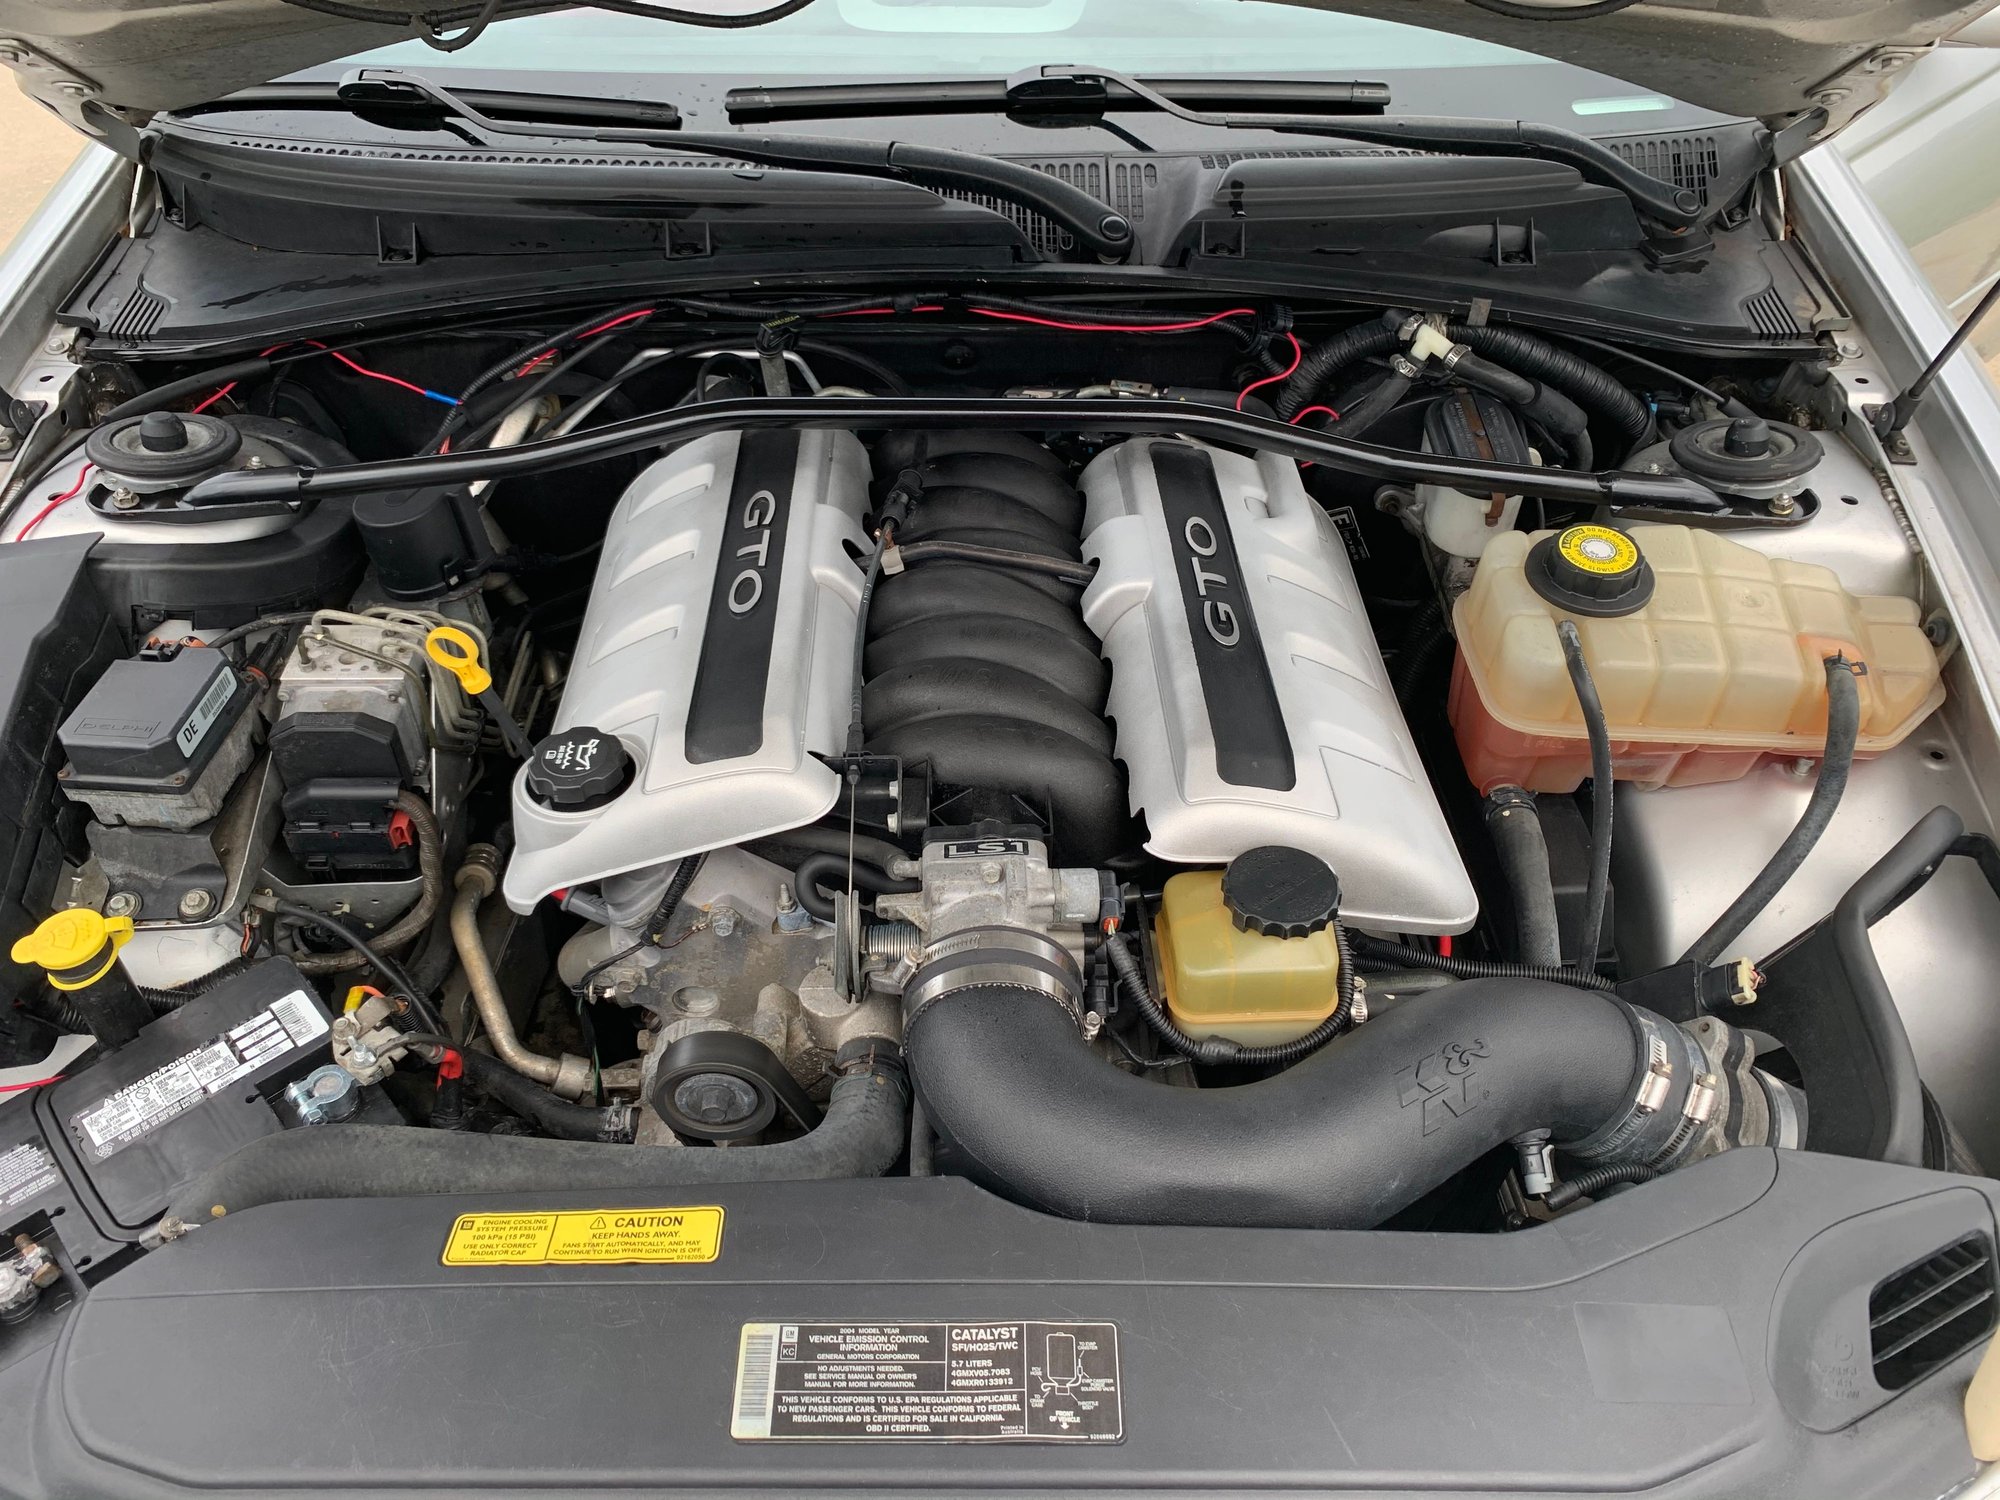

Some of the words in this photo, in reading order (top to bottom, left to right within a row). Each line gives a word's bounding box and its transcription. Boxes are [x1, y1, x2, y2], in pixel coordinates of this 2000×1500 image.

[728, 490, 775, 614] GTO
[1184, 516, 1240, 646] GTO
[182, 718, 199, 744] DE
[948, 841, 1025, 858] LS1
[113, 1046, 202, 1101] DANGER/POISON
[614, 1216, 684, 1228] CAUTION
[653, 1230, 680, 1238] AWAY.
[952, 1327, 1018, 1340] CATALYST
[809, 1335, 844, 1343] VEHICLE
[846, 1335, 888, 1343] EMISSION
[889, 1335, 929, 1343] CONTROL
[951, 1342, 1018, 1351] SFI/HO2S/TWC
[782, 1348, 795, 1356] KC
[974, 1394, 1017, 1403] APPLICABLE
[988, 1404, 1021, 1412] FEDERAL
[959, 1414, 1004, 1422] CALIFORNIA.
